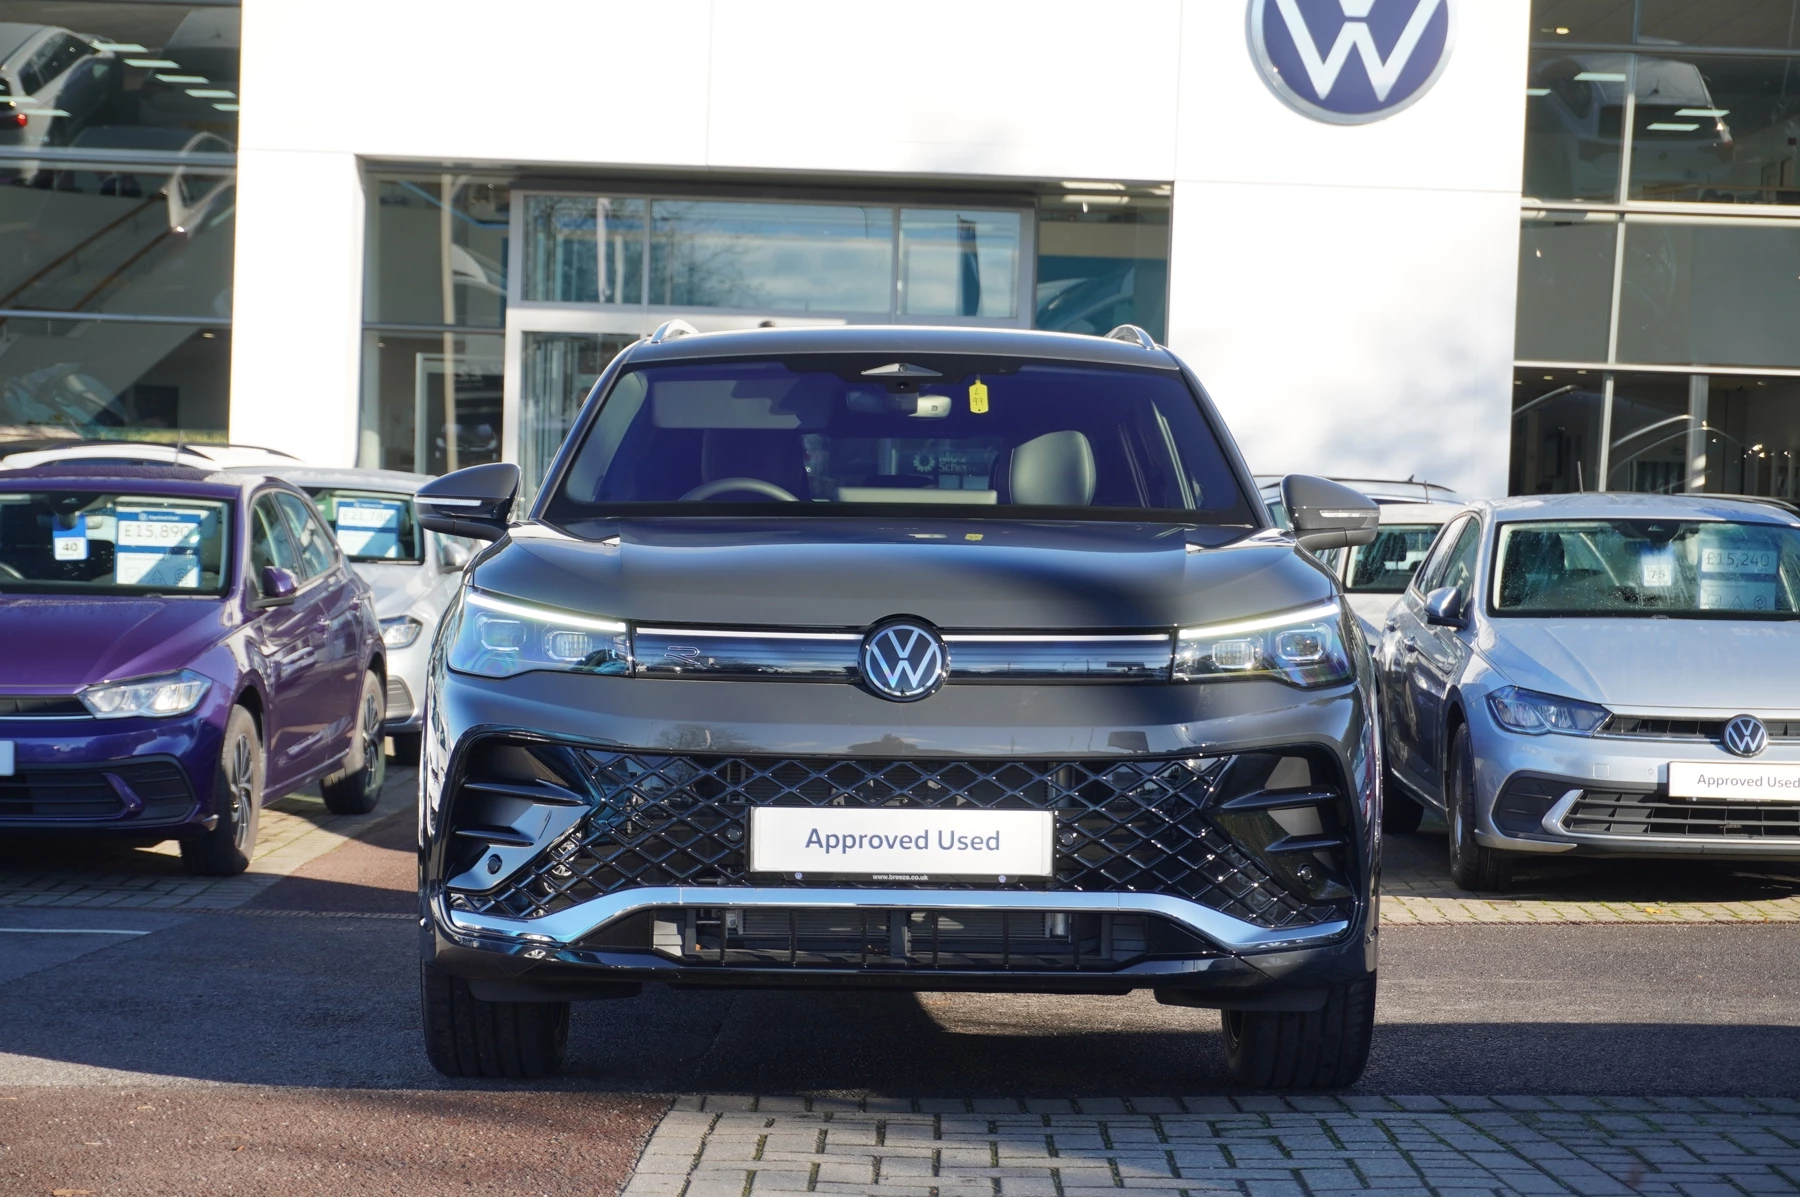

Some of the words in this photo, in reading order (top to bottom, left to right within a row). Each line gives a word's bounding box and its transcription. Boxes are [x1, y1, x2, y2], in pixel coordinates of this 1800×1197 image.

[1275, 0, 1441, 102] W
[124, 523, 190, 539] £15,890
[61, 542, 78, 552] 40
[1706, 551, 1770, 568] £15,240
[1650, 569, 1666, 580] 75
[869, 629, 937, 688] VW
[1728, 719, 1764, 751] VW
[1697, 773, 1763, 788] Approved
[1767, 776, 1800, 789] Used
[805, 828, 929, 854] Approved
[937, 829, 1000, 851] Used
[872, 873, 928, 881] www.breeze.co.uk
